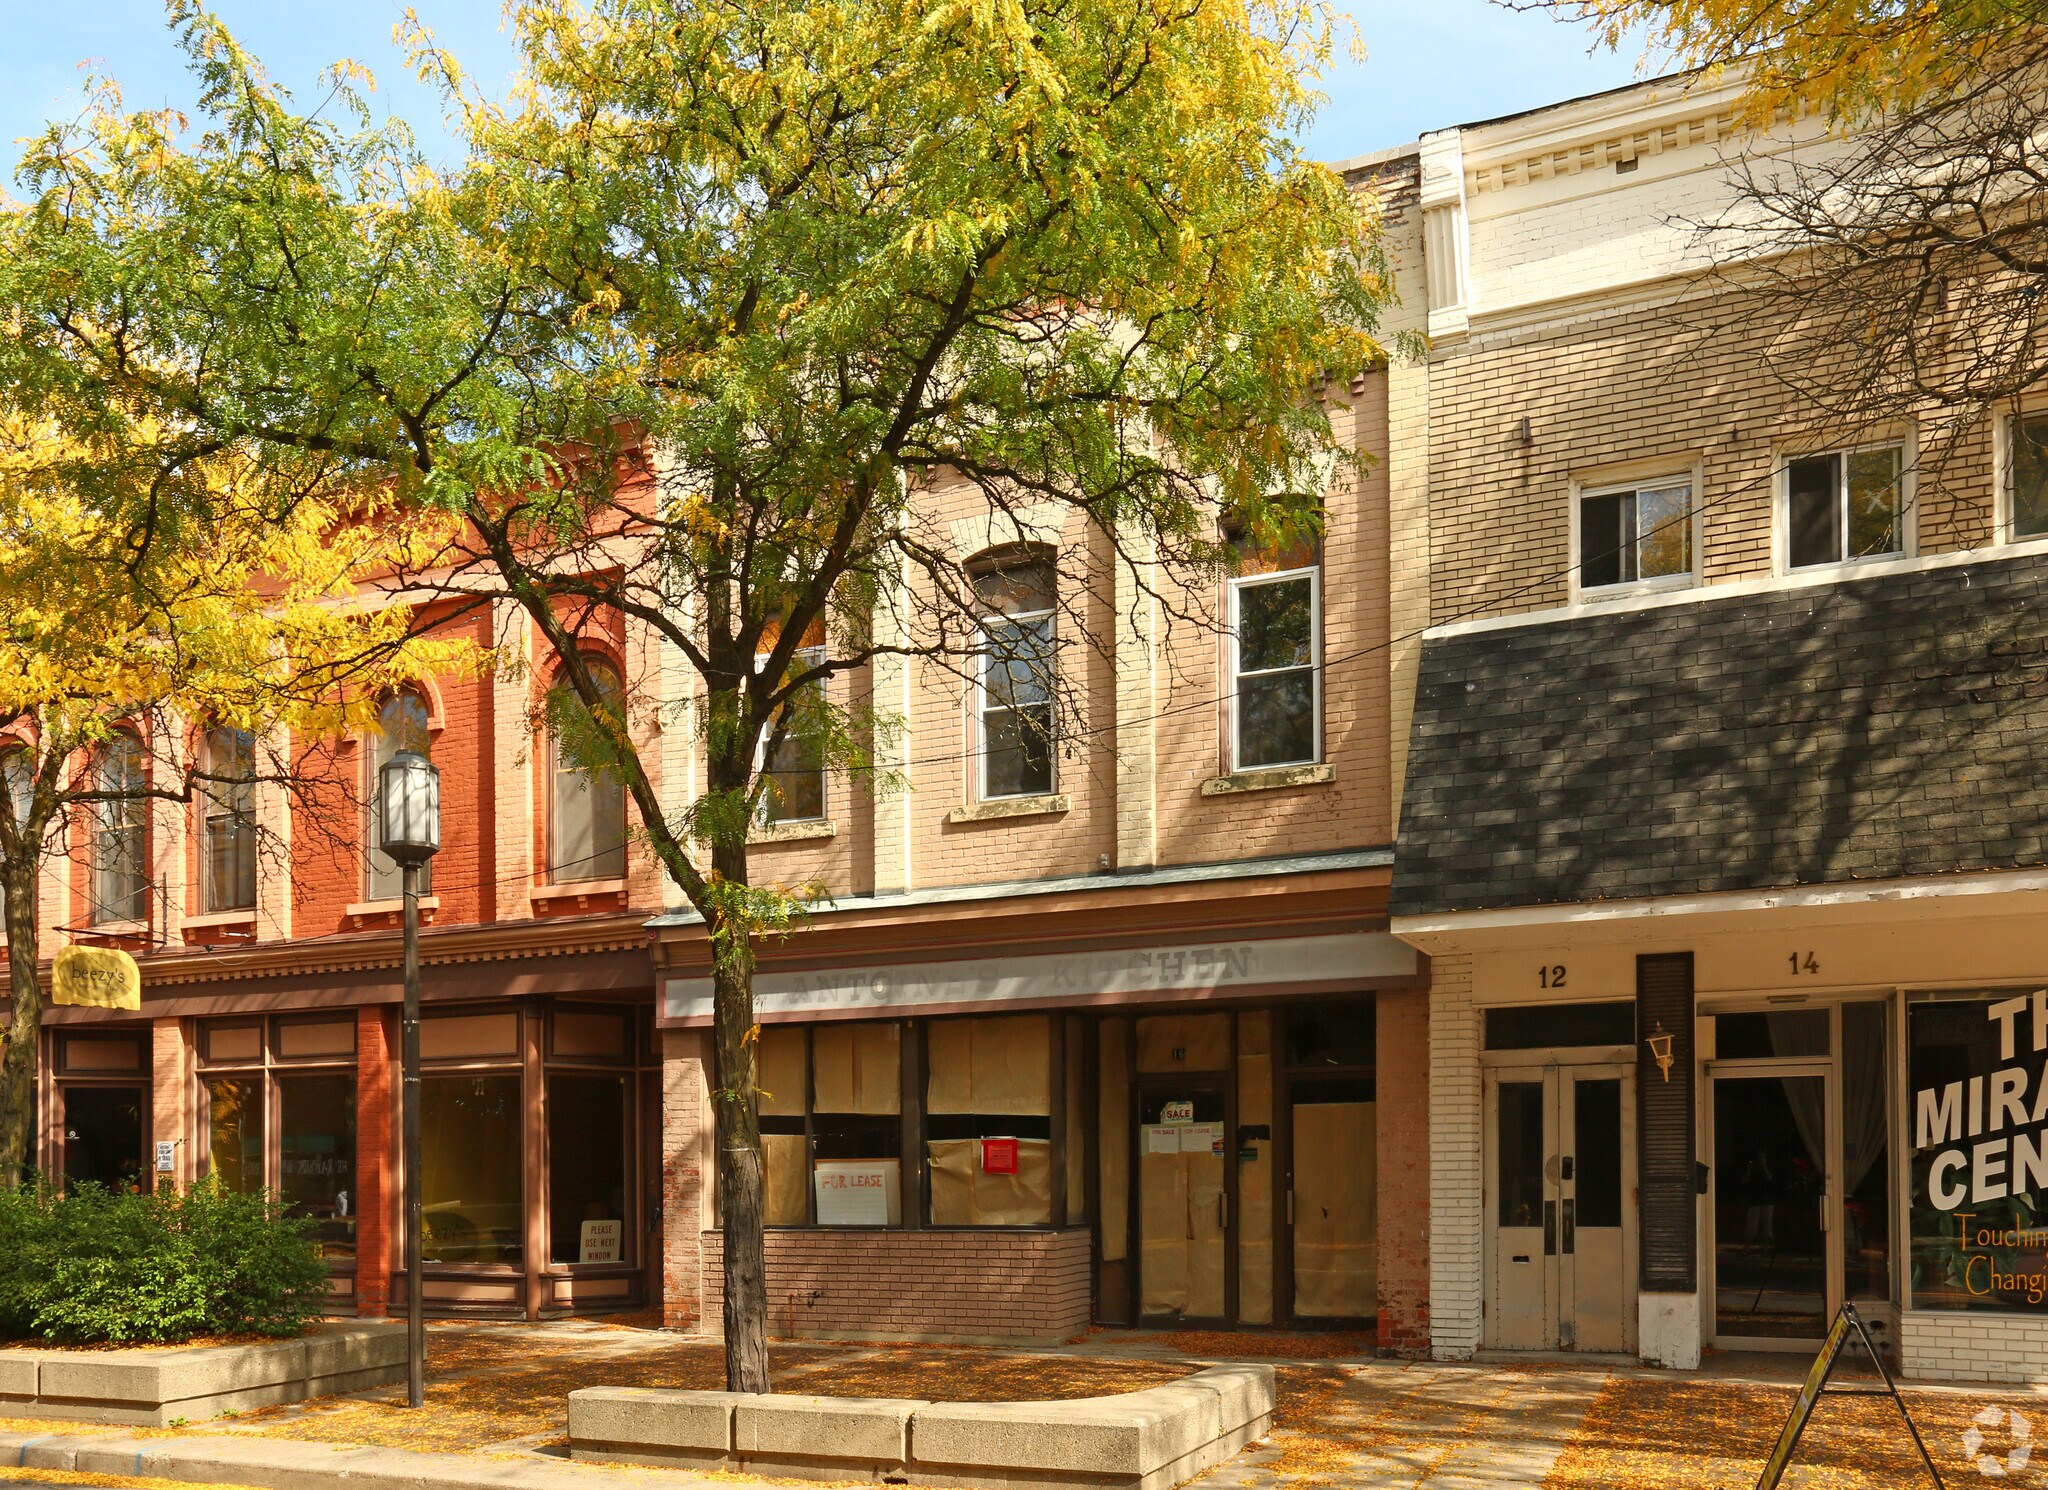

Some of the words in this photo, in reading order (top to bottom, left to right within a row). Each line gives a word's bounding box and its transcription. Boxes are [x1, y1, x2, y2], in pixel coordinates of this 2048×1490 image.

[1048, 946, 1252, 989] KITCHEN
[1788, 951, 1820, 975] 14
[72, 961, 125, 986] beezy's
[1537, 965, 1567, 989] 12
[1173, 1049, 1185, 1060] 16
[1166, 1109, 1191, 1119] SALE
[821, 1174, 848, 1189] FOR
[850, 1174, 883, 1188] LEASE
[590, 1224, 613, 1235] PLEASE
[1953, 1212, 2046, 1251] Touchin
[585, 1238, 597, 1248] USE
[600, 1237, 615, 1247] NEXT
[587, 1251, 612, 1261] WINDOW
[1965, 1254, 2047, 1304] Changi
